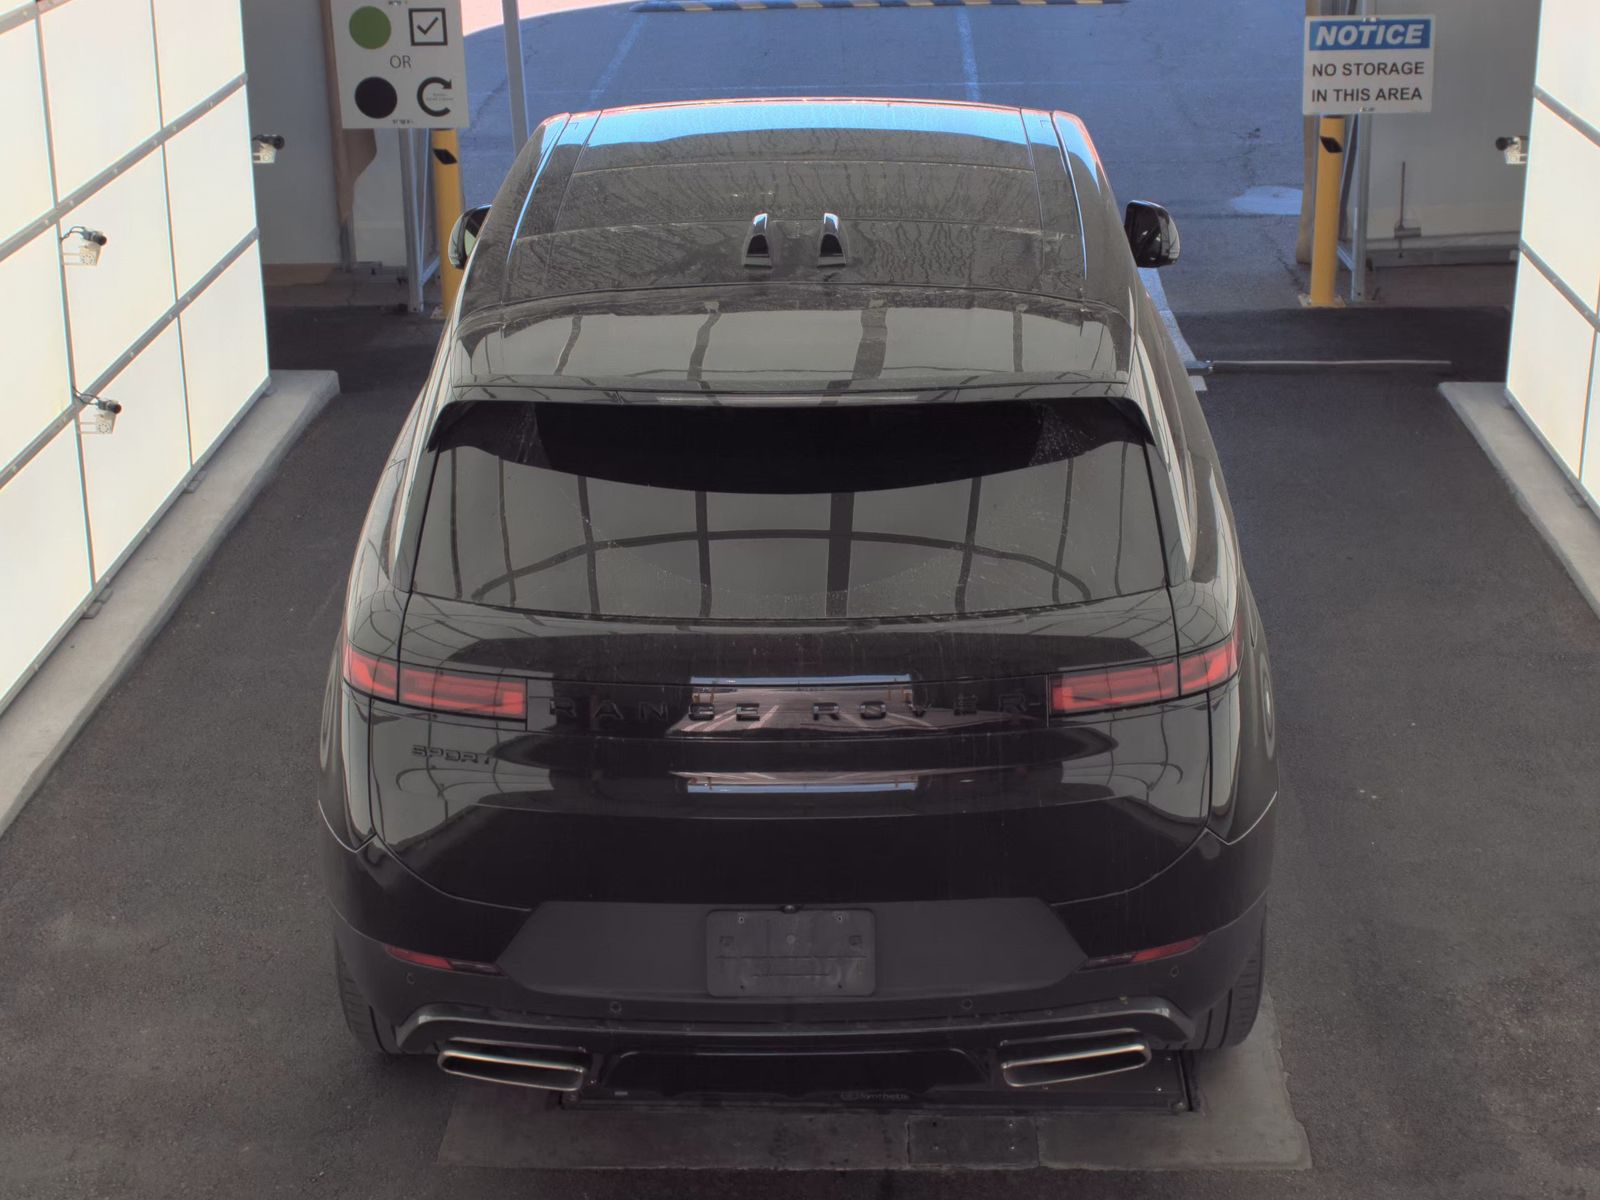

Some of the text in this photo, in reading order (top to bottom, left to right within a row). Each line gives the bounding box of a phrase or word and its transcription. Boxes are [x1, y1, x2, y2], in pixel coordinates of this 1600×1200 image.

[1315, 24, 1425, 47] NOTICE
[389, 54, 412, 69] OR
[1312, 61, 1425, 77] NO STORAGE
[1312, 87, 1423, 102] IN THIS AREA
[551, 694, 1027, 722] RANGE ROVER
[411, 744, 491, 765] SPORT
